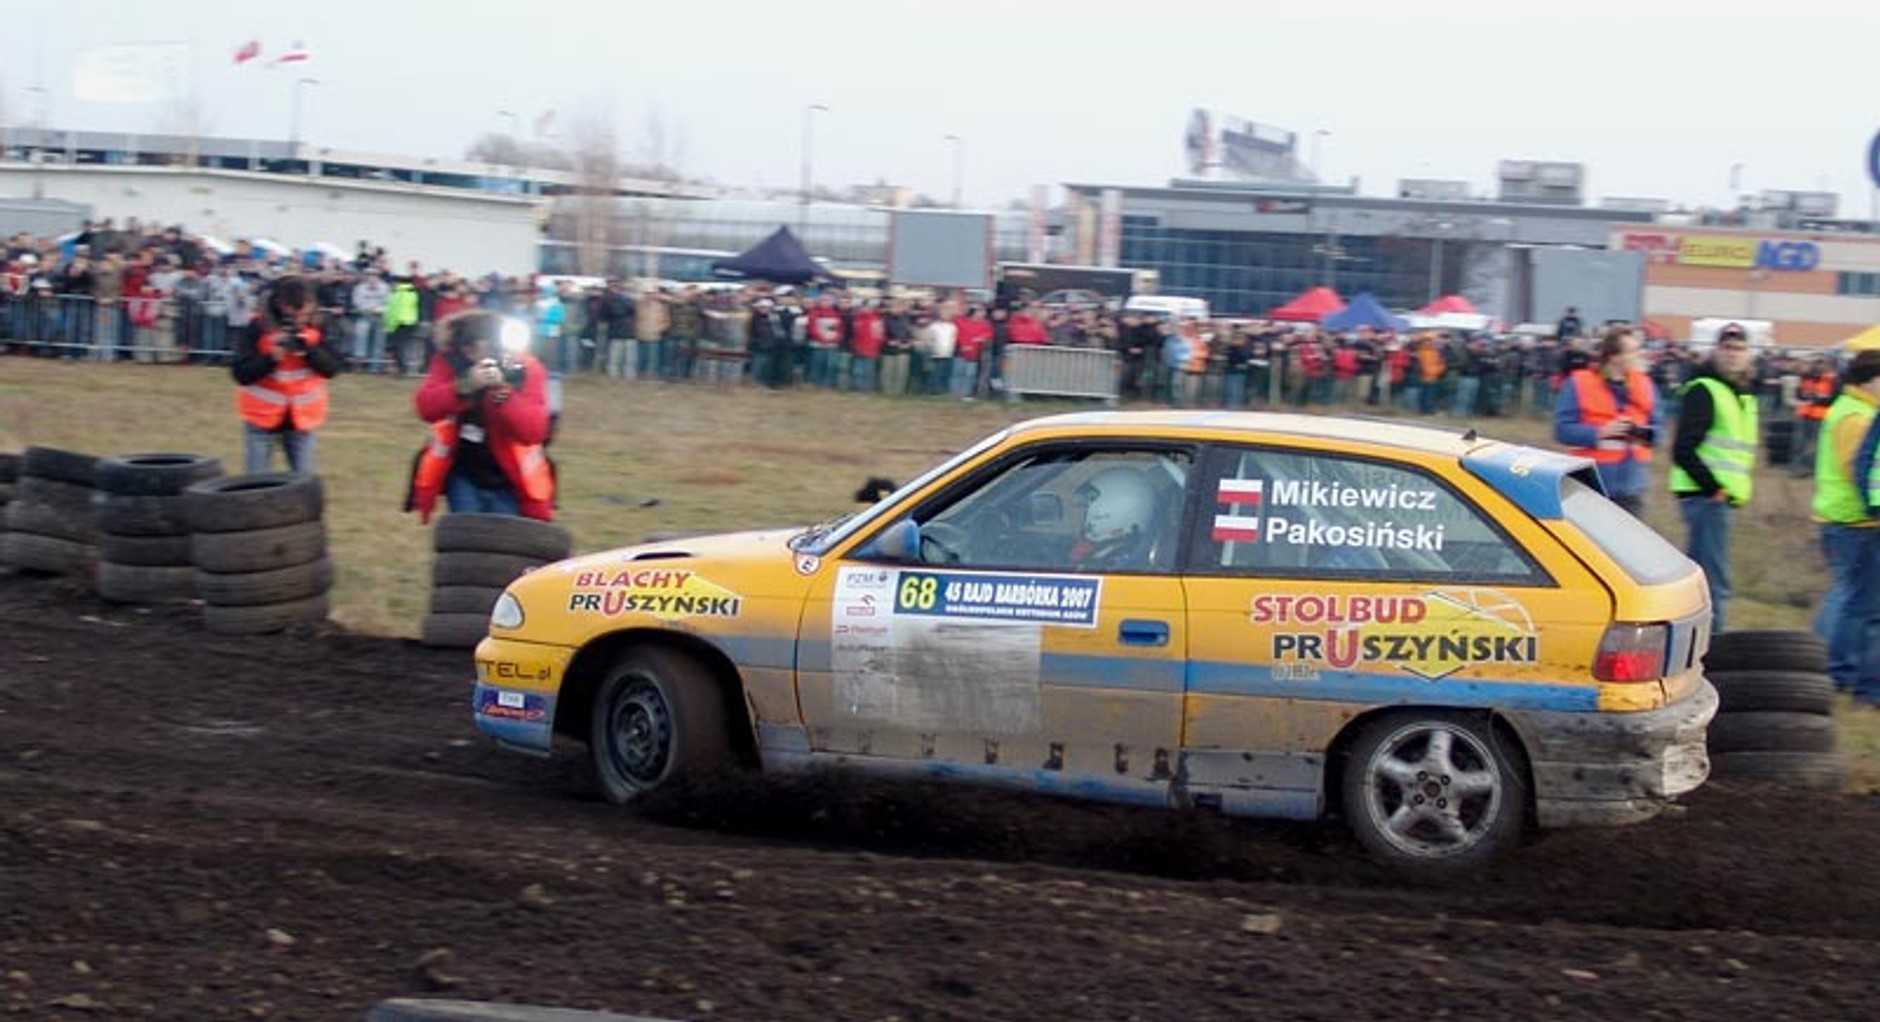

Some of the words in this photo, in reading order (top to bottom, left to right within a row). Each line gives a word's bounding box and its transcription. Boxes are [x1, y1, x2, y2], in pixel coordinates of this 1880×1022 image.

[1755, 239, 1820, 271] AGD
[1271, 481, 1437, 510] Mikiewicz
[1266, 517, 1445, 551] Pakosiński
[576, 571, 691, 589] BLACHY
[900, 576, 937, 609] 68
[945, 582, 961, 602] 45
[962, 582, 993, 603] RAJD
[994, 579, 1059, 606] BARBÓRKA
[1060, 586, 1093, 609] 2007
[569, 591, 740, 616] PRUSZYŃSKI
[1252, 596, 1428, 625] STOLBUD
[1273, 629, 1537, 669] PRUSZYŃSKI
